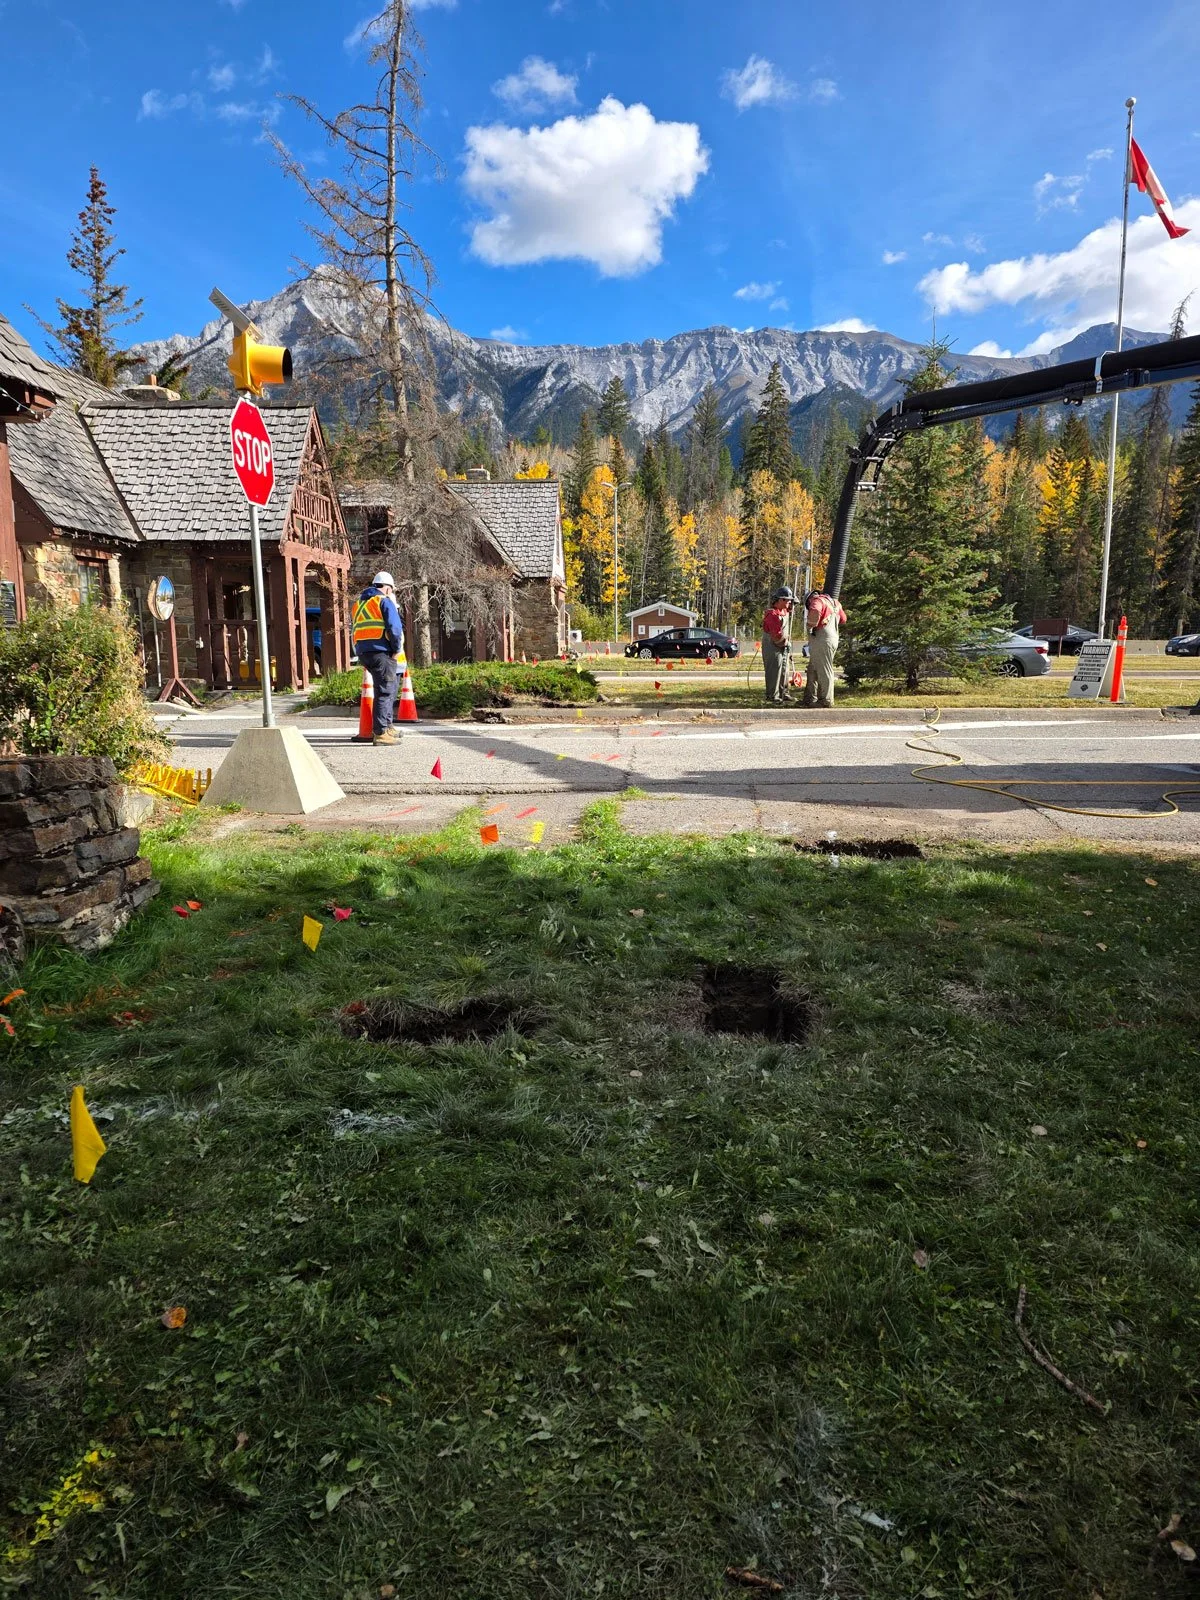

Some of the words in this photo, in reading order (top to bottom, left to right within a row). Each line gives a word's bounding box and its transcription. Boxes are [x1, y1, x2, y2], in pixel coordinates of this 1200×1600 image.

[234, 429, 271, 477] STOP
[295, 489, 329, 524] NATIONAL
[304, 520, 323, 549] PARK
[1083, 646, 1109, 654] WARNING
